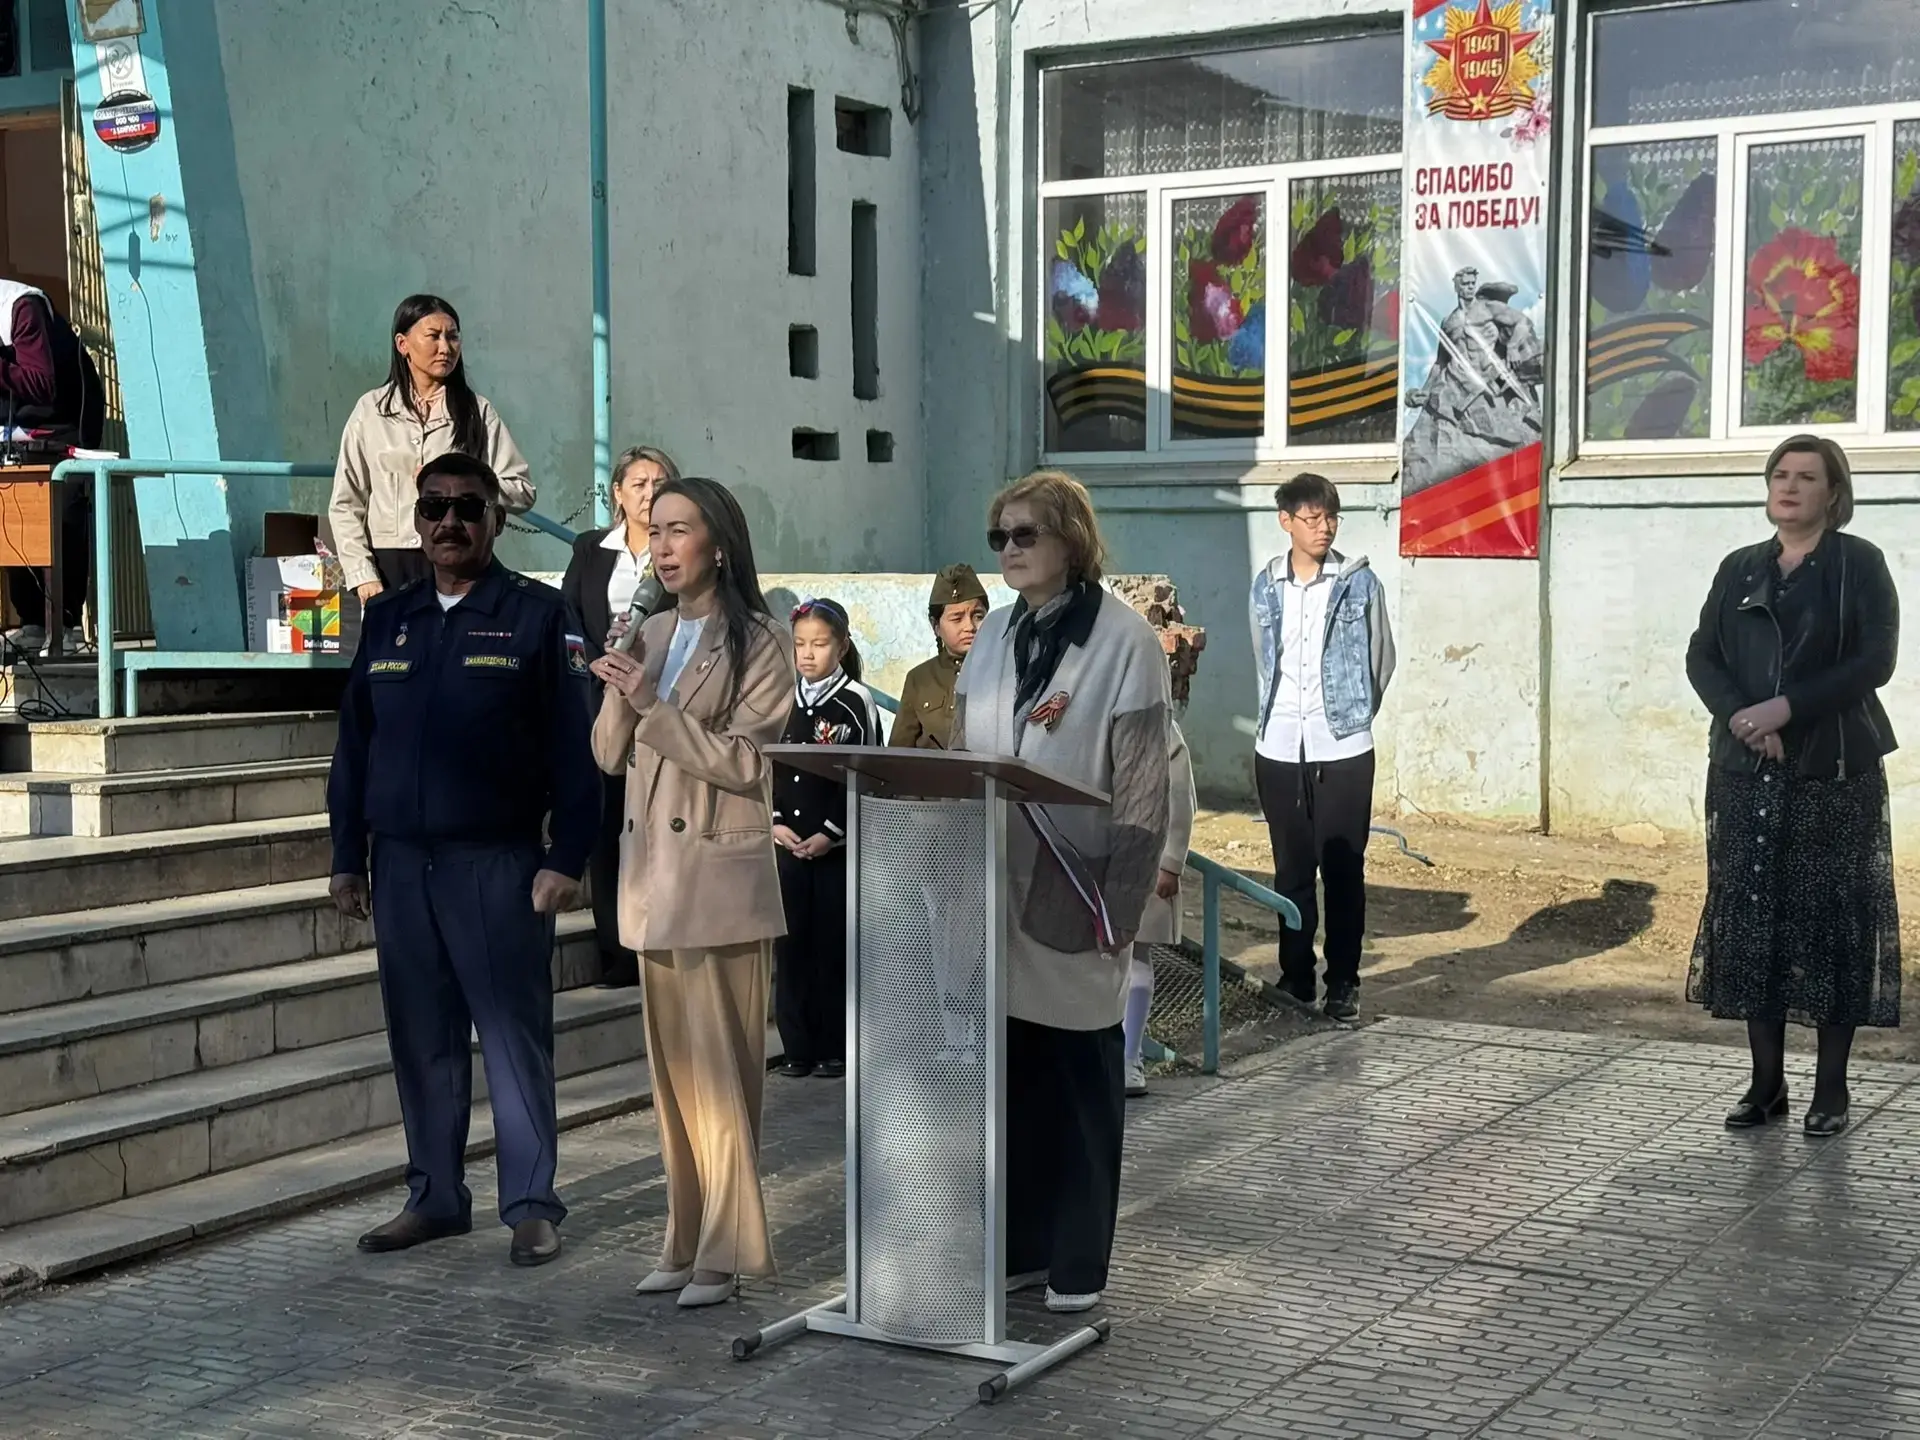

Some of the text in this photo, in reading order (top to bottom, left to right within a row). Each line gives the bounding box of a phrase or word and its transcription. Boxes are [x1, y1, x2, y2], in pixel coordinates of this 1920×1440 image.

[1461, 34, 1500, 55] 1941
[1460, 58, 1503, 79] 1945
[1416, 162, 1513, 195] СПАСИБО
[1415, 196, 1540, 230] ЗА ПОБЕДУ!
